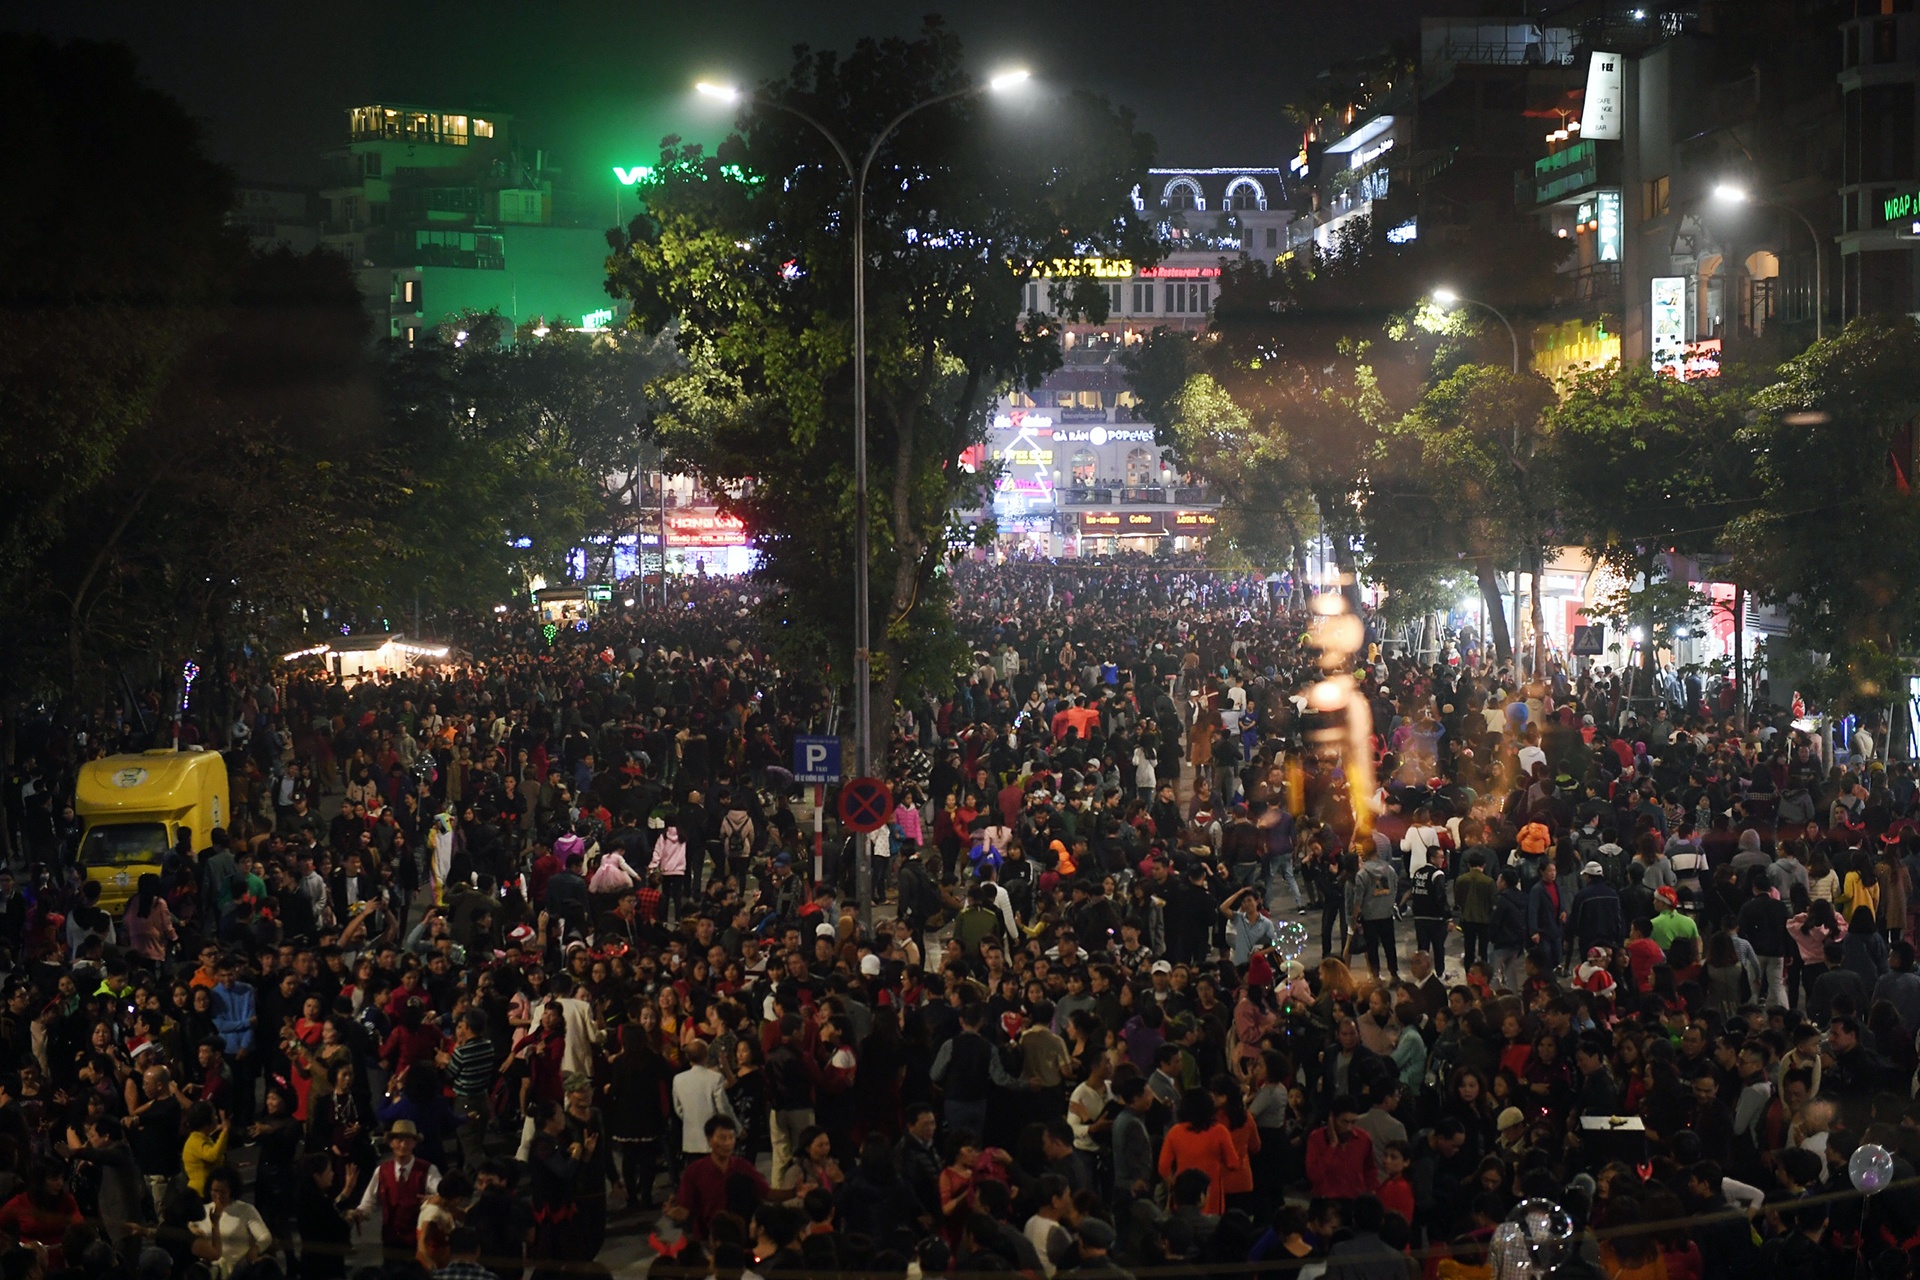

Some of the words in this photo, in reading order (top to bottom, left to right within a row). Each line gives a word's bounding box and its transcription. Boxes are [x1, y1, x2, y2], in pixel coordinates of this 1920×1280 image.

[1884, 194, 1911, 221] WRAP
[1912, 198, 1918, 215] &
[1600, 209, 1618, 261] SPA
[1129, 515, 1152, 525] Coffee
[806, 744, 827, 772] P
